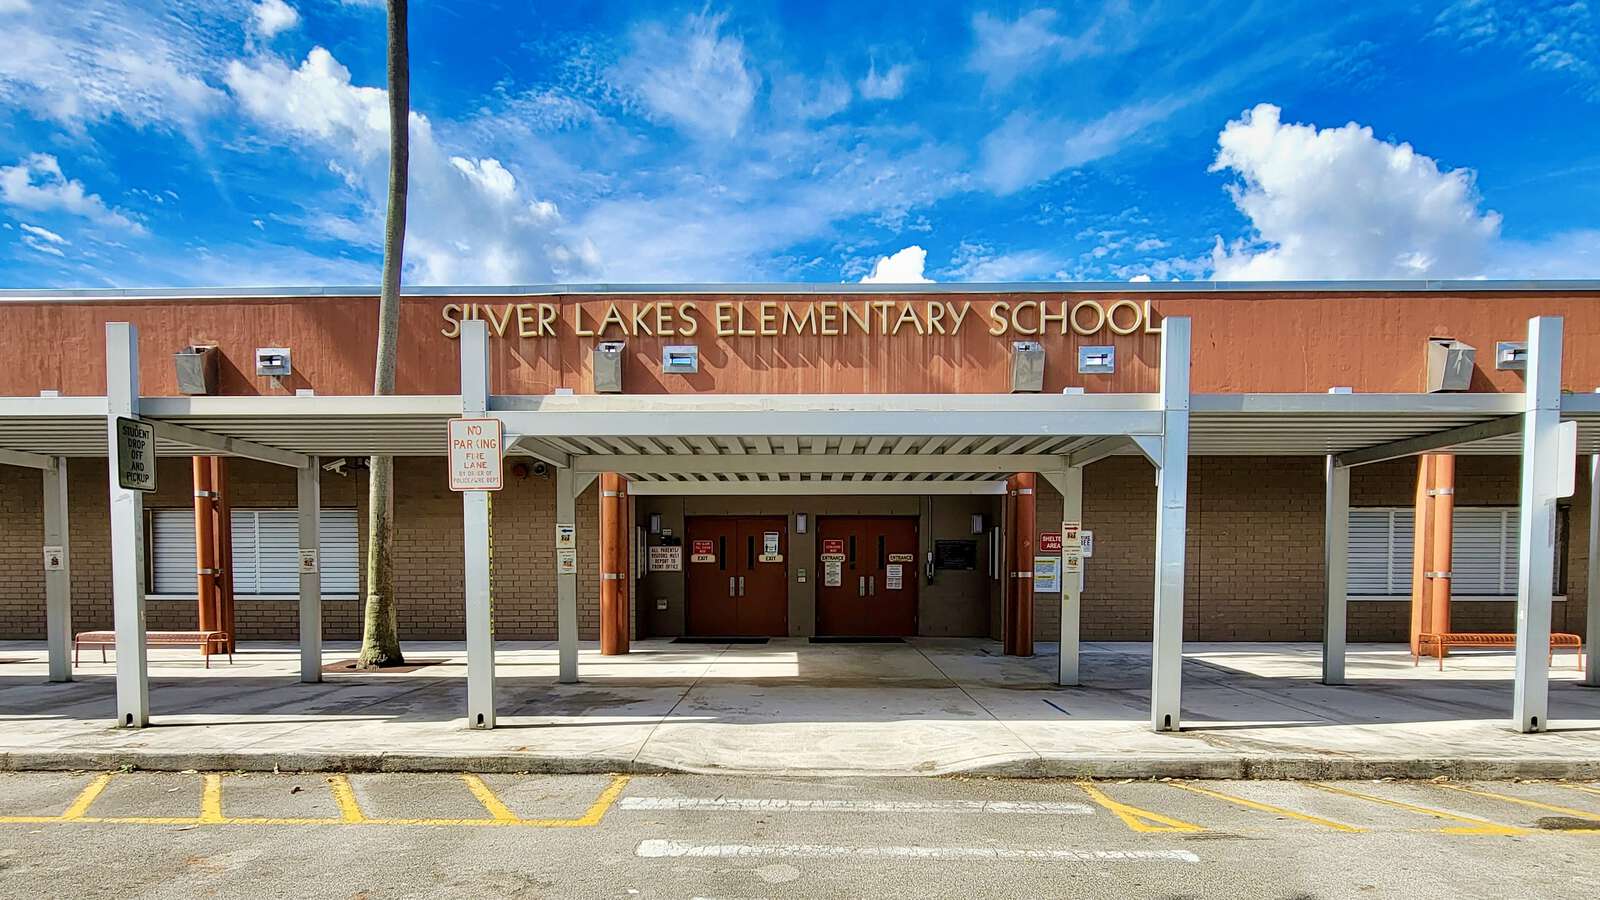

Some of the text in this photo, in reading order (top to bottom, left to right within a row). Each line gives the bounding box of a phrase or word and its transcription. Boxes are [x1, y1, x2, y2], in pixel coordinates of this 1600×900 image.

[575, 302, 698, 337] LAKES
[714, 300, 971, 337] ELEMENTARY
[988, 298, 1162, 337] SCHOOL
[122, 425, 150, 440] STUDENT
[467, 425, 482, 436] NO
[127, 438, 146, 450] DROP
[453, 439, 497, 449] PARKING
[131, 450, 144, 460] OFF
[465, 452, 485, 460] FIRE
[131, 461, 145, 472] AND
[463, 461, 488, 469] LANE
[126, 471, 150, 483] PICKUP
